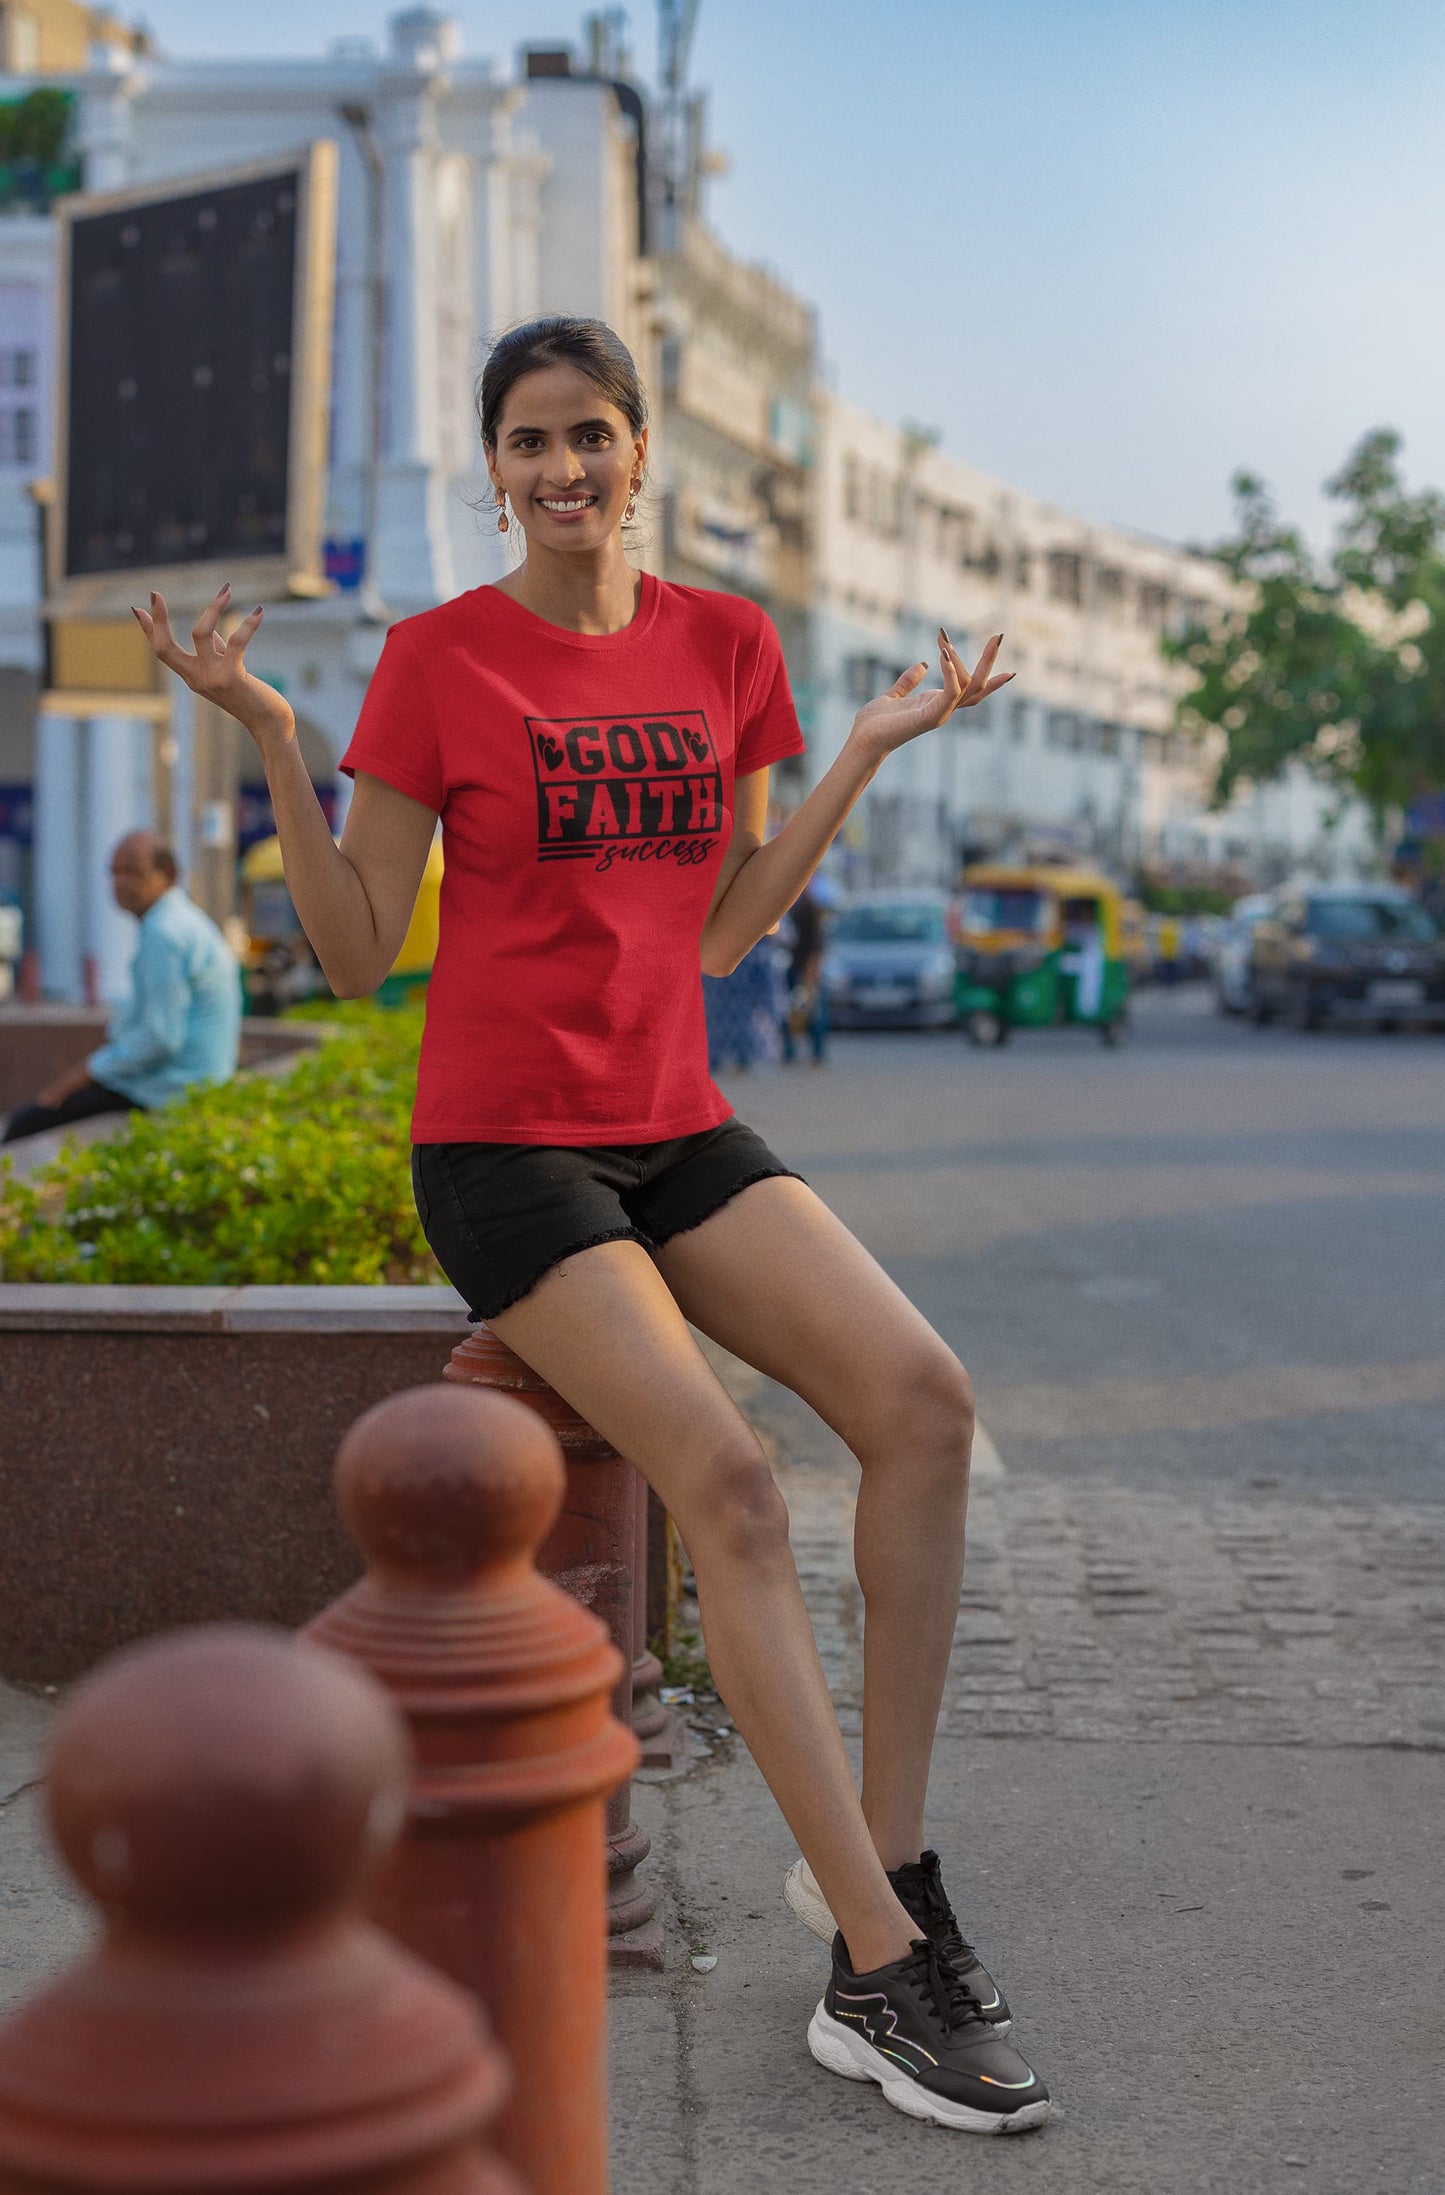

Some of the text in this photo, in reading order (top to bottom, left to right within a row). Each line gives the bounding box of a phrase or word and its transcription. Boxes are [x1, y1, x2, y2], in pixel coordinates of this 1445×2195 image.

[564, 722, 688, 775] GOD
[545, 776, 716, 838] FAITH
[595, 838, 719, 873] success
